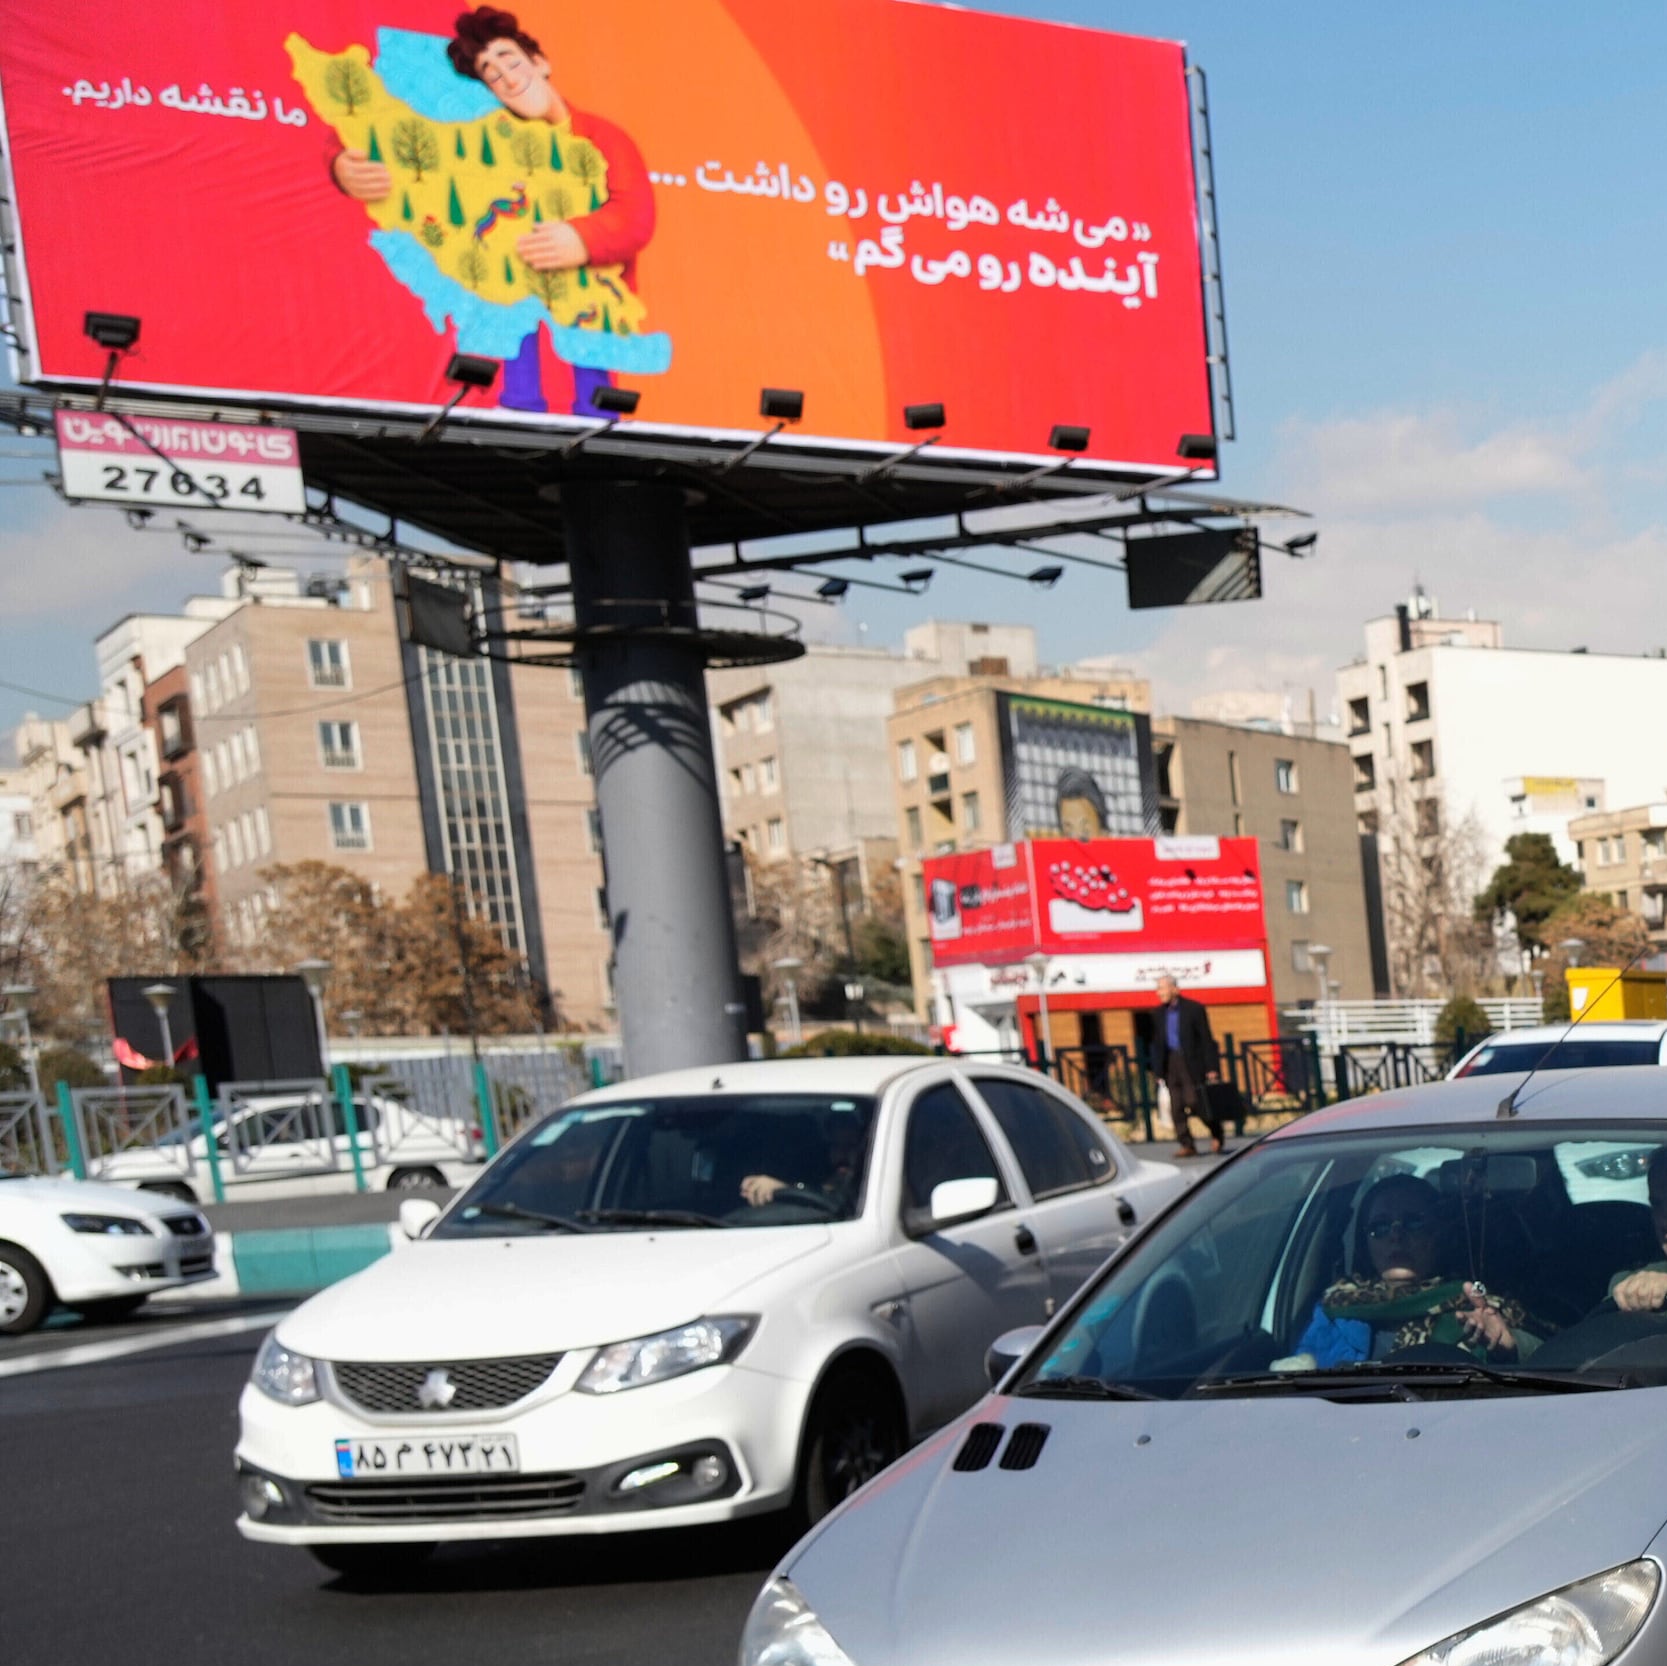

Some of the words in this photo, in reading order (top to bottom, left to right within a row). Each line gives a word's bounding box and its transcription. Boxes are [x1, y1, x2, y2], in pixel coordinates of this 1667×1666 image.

[62, 77, 153, 109] داریم.
[159, 82, 268, 121] نقشه
[274, 96, 308, 127] ما
[695, 160, 816, 202] داشت
[824, 180, 869, 218] رو
[877, 180, 1000, 231] هواش
[977, 253, 1022, 293] رو
[1027, 251, 1160, 310] آینده
[201, 428, 293, 460] کانون
[103, 465, 265, 502] 27634
[356, 1445, 387, 1469] ۸۵
[398, 1443, 412, 1468] م
[481, 1444, 513, 1467] ۲۱
